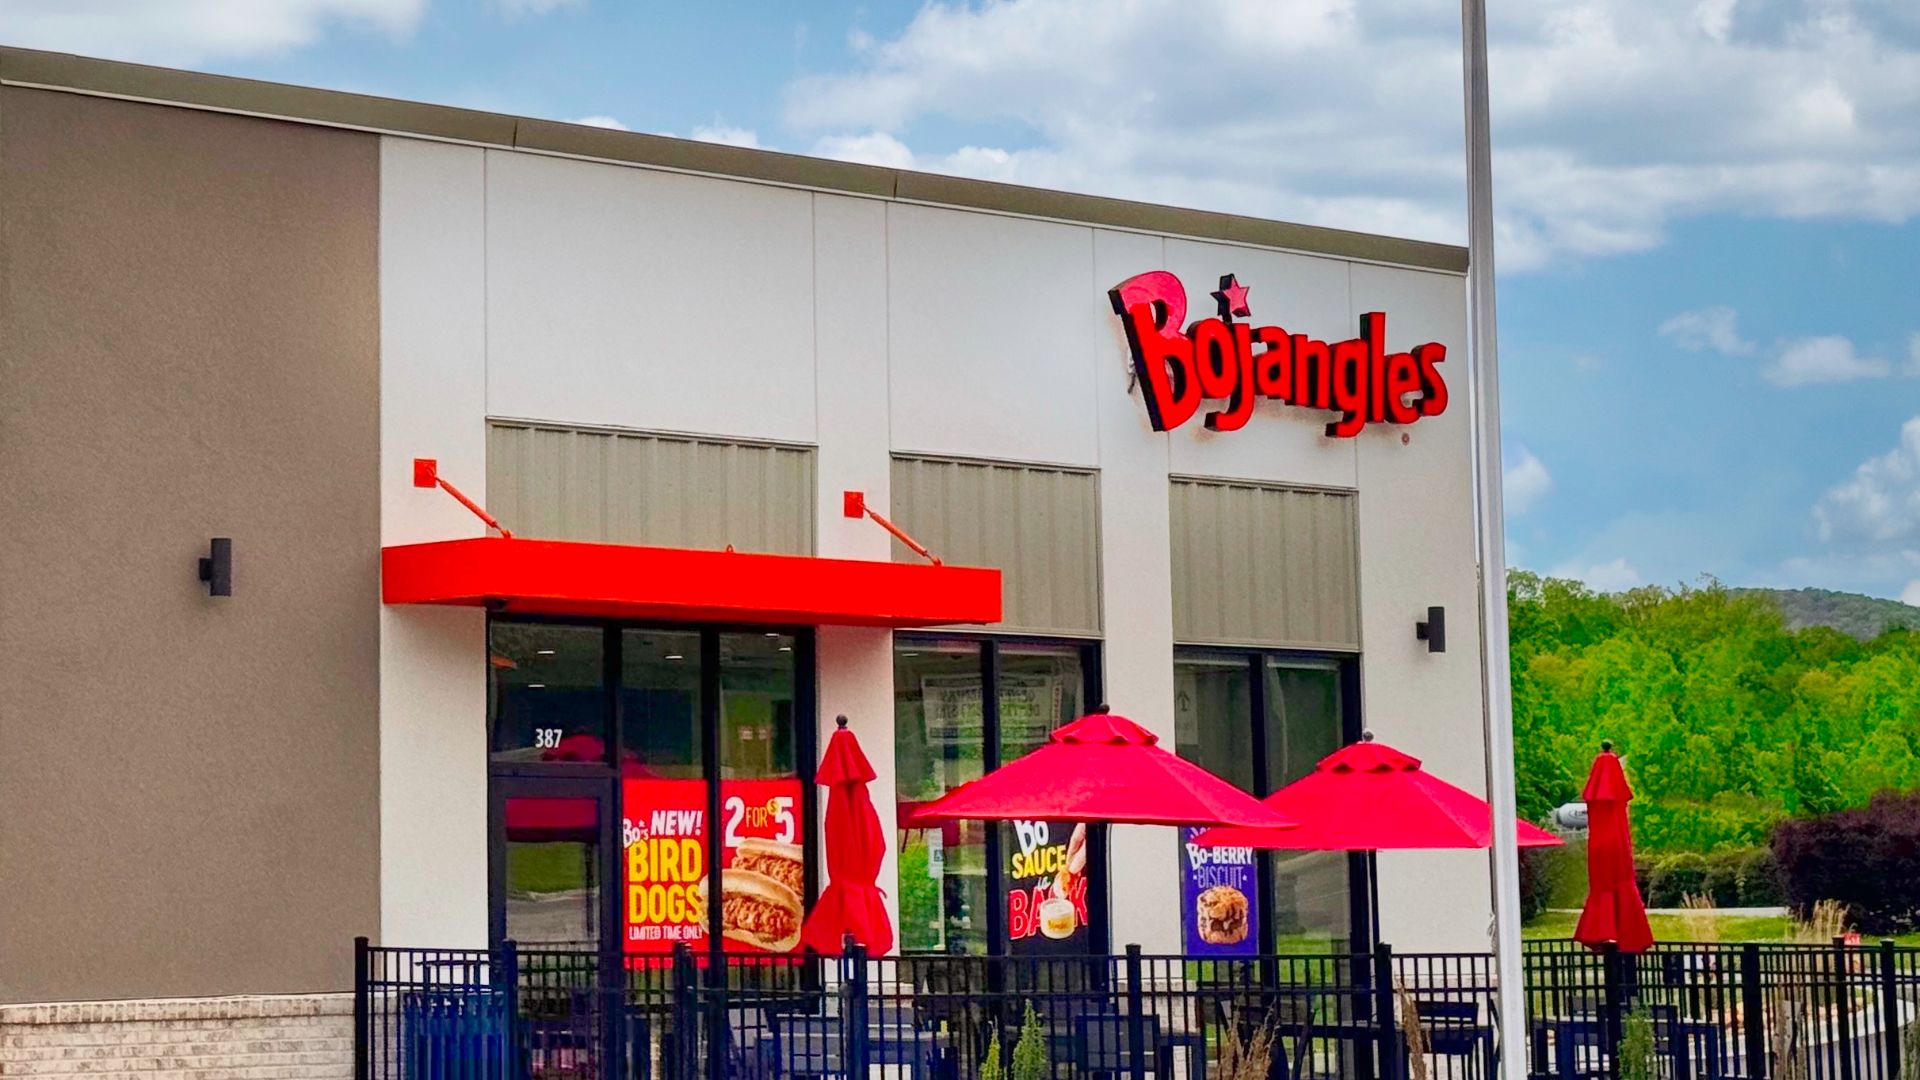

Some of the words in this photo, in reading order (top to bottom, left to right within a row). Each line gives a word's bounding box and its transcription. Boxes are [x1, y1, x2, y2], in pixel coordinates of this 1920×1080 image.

[1109, 271, 1448, 437] Bojangles
[535, 728, 563, 748] 387
[650, 810, 703, 836] NEW!
[725, 797, 746, 847] 2
[746, 807, 767, 828] FOR
[629, 839, 702, 882] BIRD
[1011, 845, 1067, 880] SAUCE
[1197, 866, 1244, 889] BISCUIT
[629, 884, 700, 924] DOGS
[1008, 877, 1088, 940] BAK
[629, 926, 661, 941] LIMITED
[662, 925, 682, 940] TIME
